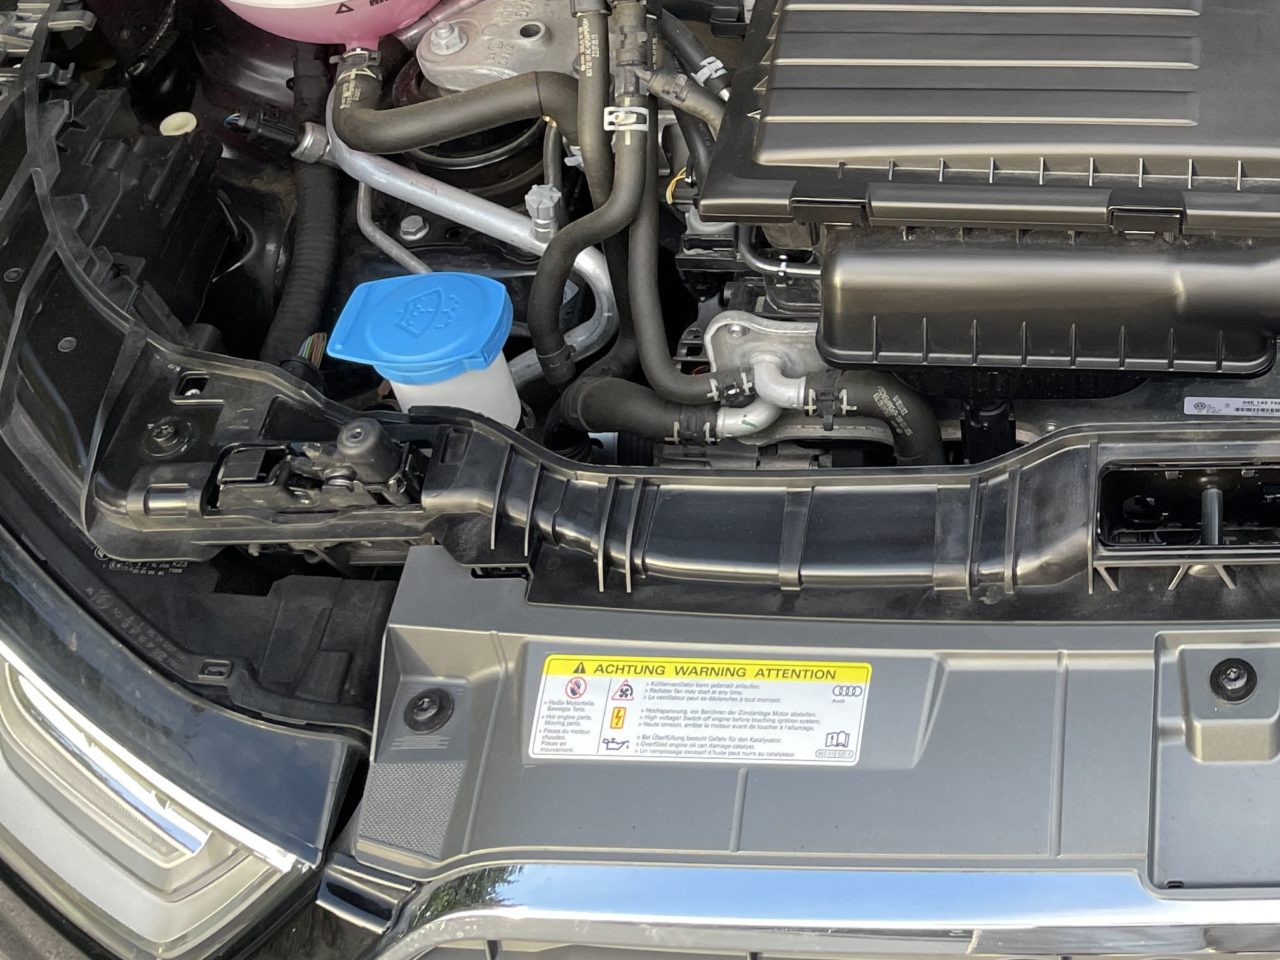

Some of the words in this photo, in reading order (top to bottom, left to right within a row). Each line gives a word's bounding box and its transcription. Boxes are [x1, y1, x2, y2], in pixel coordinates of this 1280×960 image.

[592, 664, 665, 676] ACHTUNG
[673, 666, 747, 678] WARNING
[754, 668, 836, 680] ATTENTION
